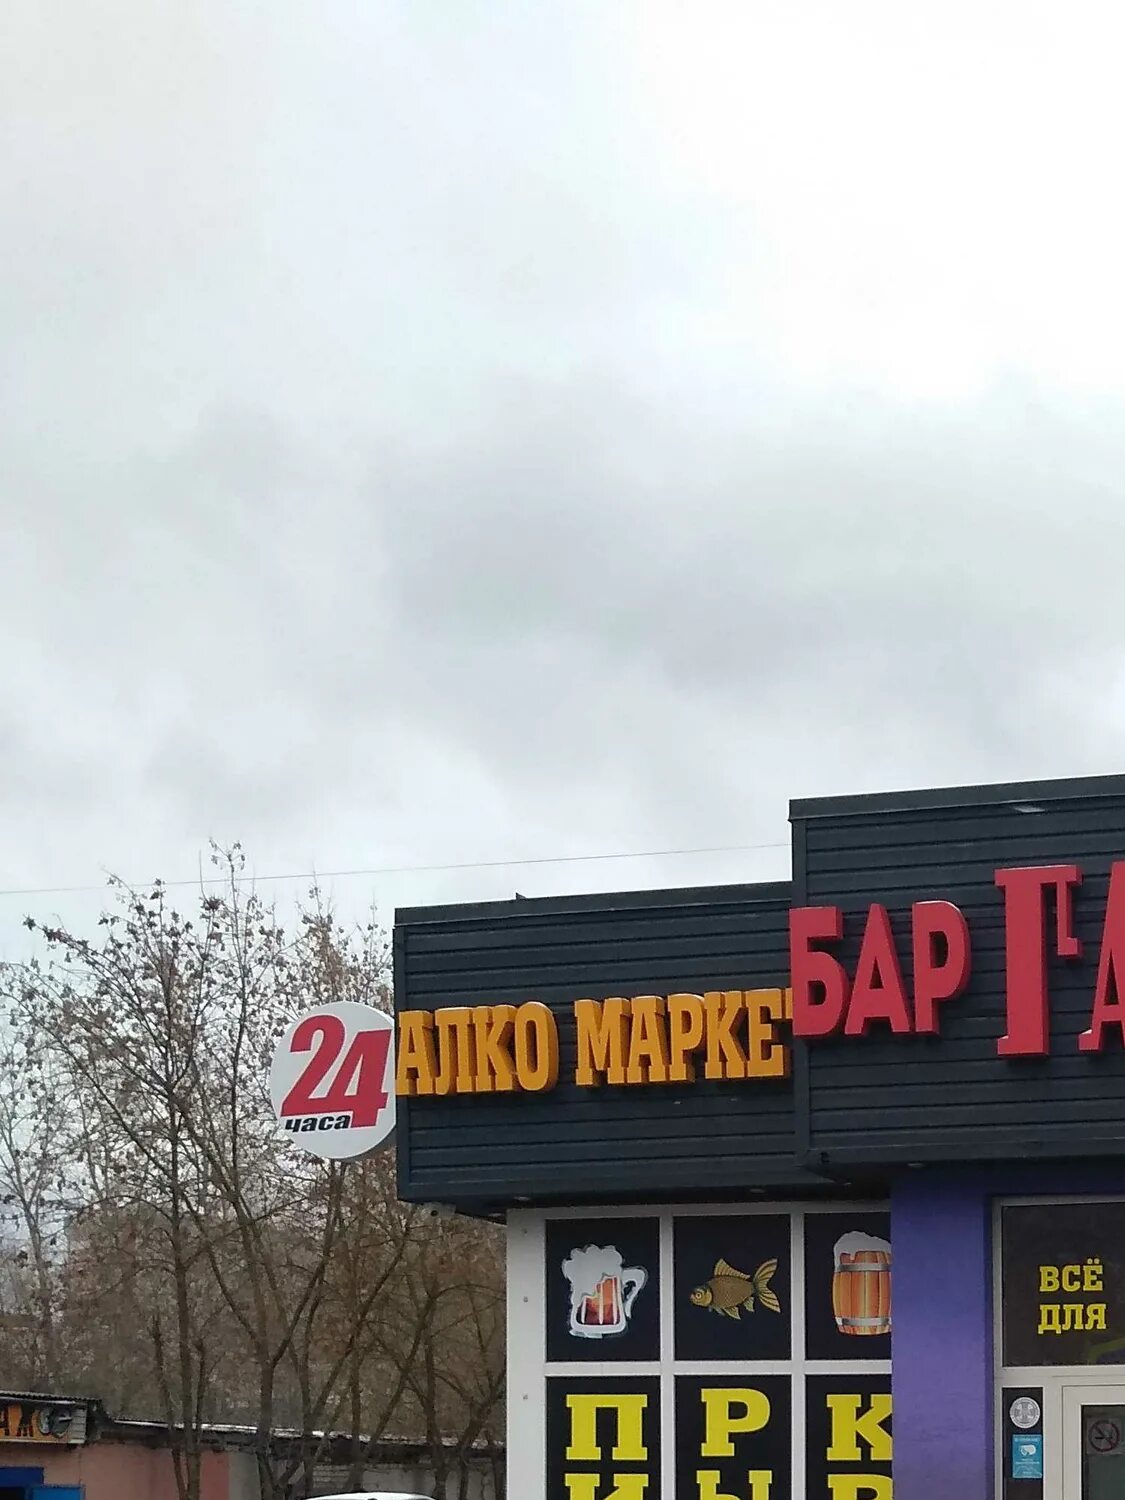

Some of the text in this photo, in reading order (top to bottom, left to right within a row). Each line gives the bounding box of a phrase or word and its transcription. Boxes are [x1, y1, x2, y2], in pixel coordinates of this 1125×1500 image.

[788, 902, 970, 1036] БАР
[280, 1014, 392, 1128] 24
[395, 987, 793, 1096] АЛКО МАРКЕ
[284, 1114, 351, 1133] часа
[1038, 1258, 1104, 1292] ВСЁ
[1037, 1303, 1107, 1334] ДЛЯ
